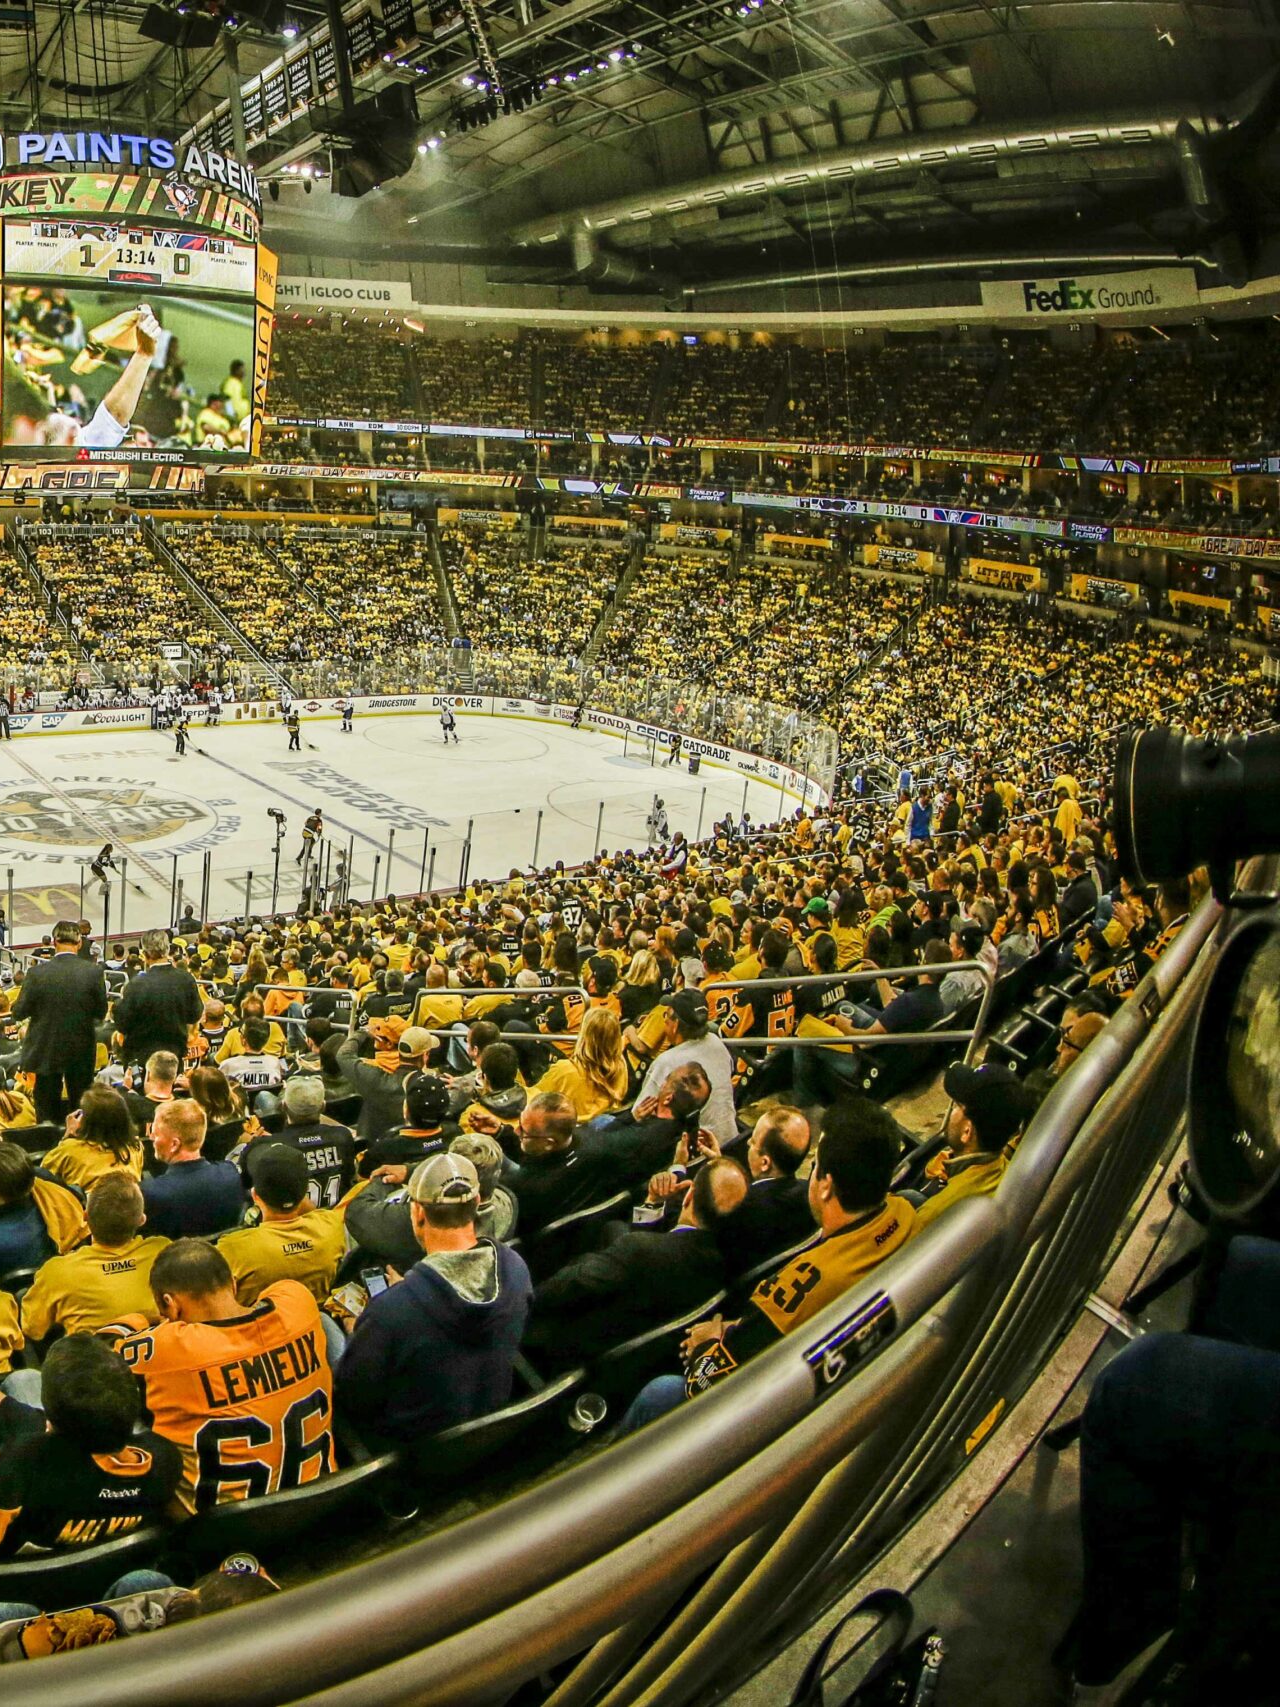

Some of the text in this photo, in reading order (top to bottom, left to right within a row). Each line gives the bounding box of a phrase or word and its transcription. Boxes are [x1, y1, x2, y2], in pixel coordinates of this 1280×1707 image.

[348, 16, 371, 37] 1990-91
[288, 56, 309, 75] 1992-93
[264, 73, 284, 92] 1993-94
[18, 131, 176, 170] PAINTS
[183, 145, 261, 206] ARENA
[80, 244, 96, 267] 1
[116, 248, 156, 266] 13:14
[174, 252, 191, 275] 0
[310, 286, 391, 301] IGLOO CLUB
[1023, 279, 1156, 312] FedEx Ground
[252, 316, 270, 447] UPMC
[338, 421, 354, 429] ANH
[396, 424, 420, 432] 10:00PM
[89, 451, 184, 462] MITSUBISHI ELECTRIC
[261, 466, 268, 474] A
[269, 466, 317, 476] GREAT
[321, 467, 347, 477] DAY
[689, 488, 726, 498] STANLEY CUP
[458, 511, 486, 519] STANLEY
[862, 503, 928, 519] 1 13:14 0
[38, 528, 52, 536] 103
[111, 527, 125, 535] 103
[1071, 523, 1108, 534] STANLEY CUP
[1074, 532, 1103, 541] PLAYOFFS
[879, 548, 905, 557] STANLEY
[1245, 541, 1267, 557] DAY
[976, 566, 999, 578] LET'S
[1000, 570, 1011, 579] GO
[368, 698, 417, 709] BRIDGESTONE
[432, 696, 483, 708] DISCOVER
[9, 716, 30, 729] SAP
[42, 714, 62, 727] SAP
[91, 712, 146, 724] Coors LIGHT
[587, 713, 632, 731] HONDA
[636, 724, 676, 745] GEICO
[682, 739, 731, 762] GATORADE
[737, 761, 761, 774] OLYMPIC
[52, 775, 158, 788] ARENA
[294, 772, 416, 832] PLAYOFFS
[317, 766, 451, 829] STANLEY CUP
[46, 800, 195, 827] YEARS
[142, 815, 242, 862] PPG PAINTS
[853, 825, 870, 842] 29
[243, 1072, 270, 1085] MALKIN
[299, 1135, 322, 1144] Reebok
[423, 1137, 444, 1149] Reebok
[306, 1146, 342, 1170] SSEL
[874, 1219, 900, 1247] Reebok
[282, 1239, 314, 1253] UPMC
[102, 1258, 137, 1273] UPMC
[199, 1333, 322, 1410] LEMIEUX
[195, 1389, 333, 1508] 66
[98, 1486, 141, 1500] Reebok
